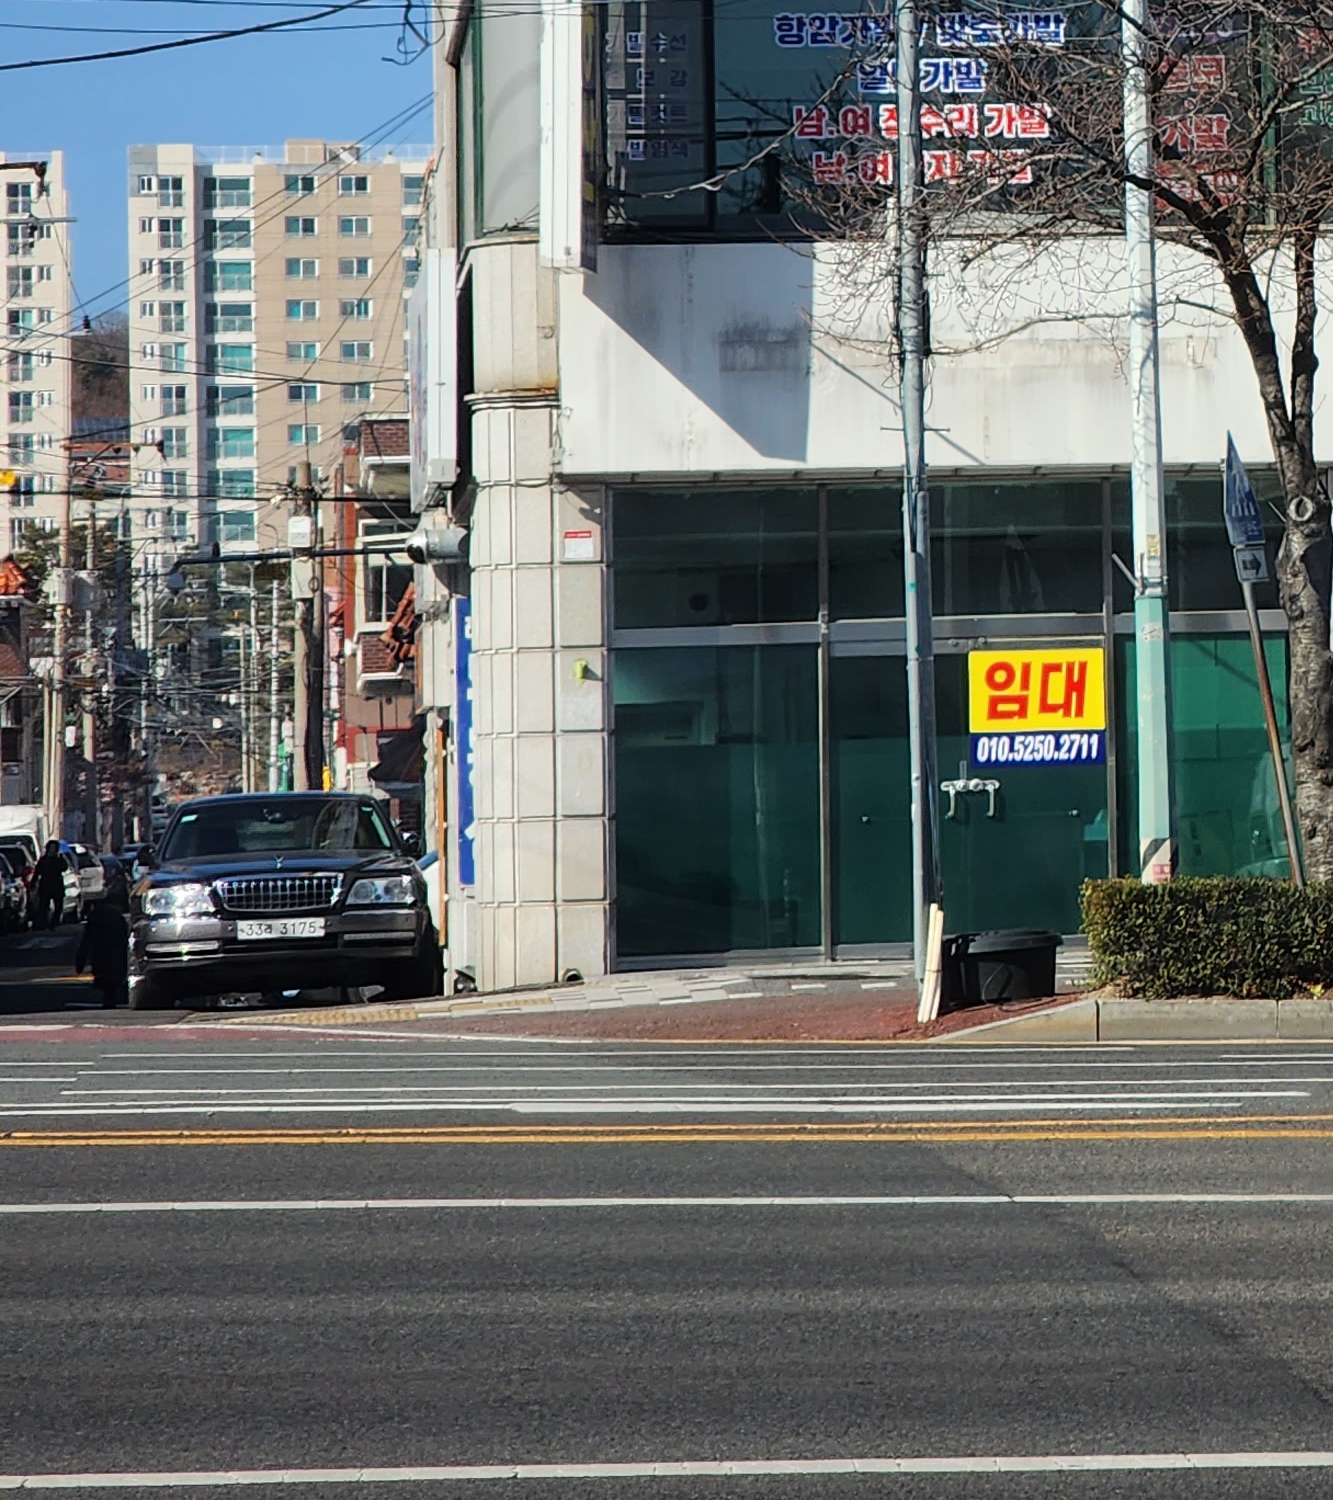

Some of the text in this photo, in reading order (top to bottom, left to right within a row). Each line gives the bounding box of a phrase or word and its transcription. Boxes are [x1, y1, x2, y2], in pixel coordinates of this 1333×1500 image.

[983, 658, 1090, 723] 임대
[976, 732, 1099, 765] 010.5250.2711
[279, 921, 317, 936] 3175
